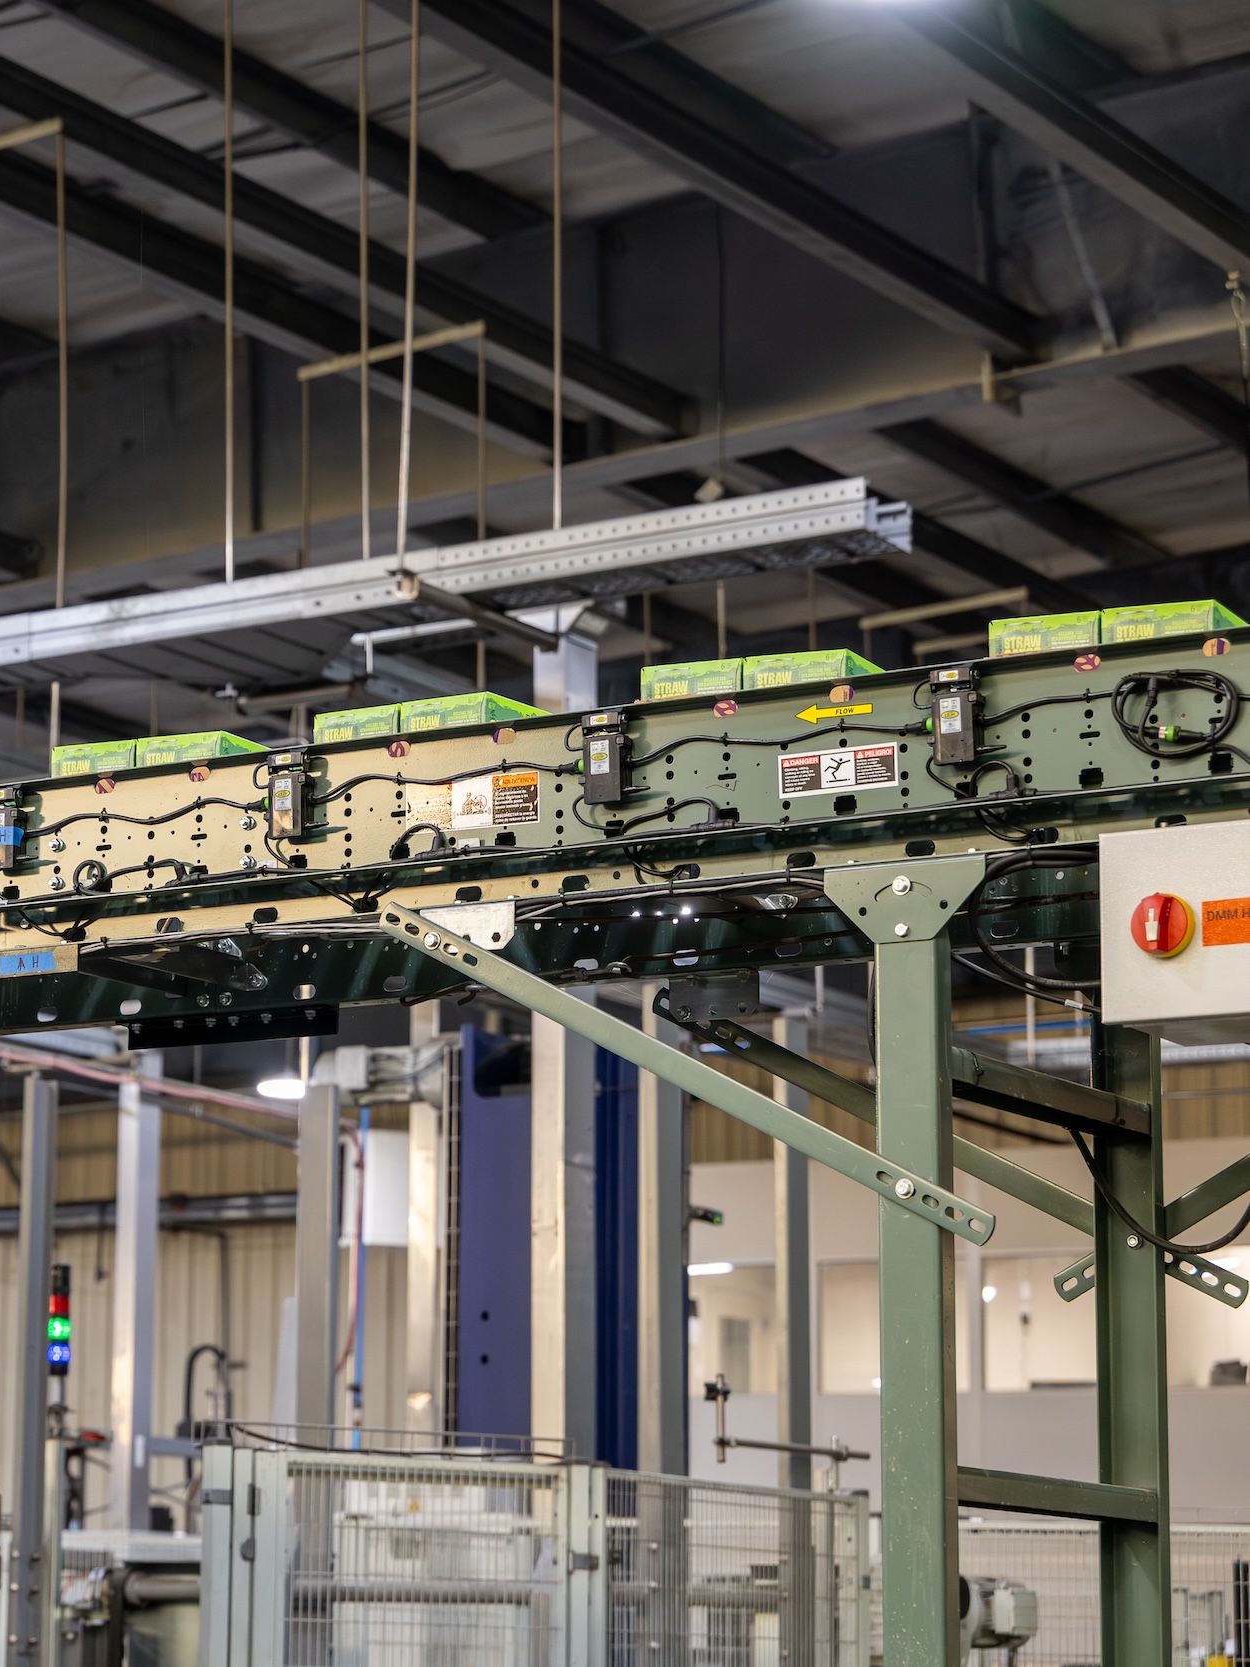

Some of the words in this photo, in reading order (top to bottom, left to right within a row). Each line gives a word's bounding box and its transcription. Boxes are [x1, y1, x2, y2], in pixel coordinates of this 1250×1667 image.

[1116, 623, 1155, 638] STRAW
[1004, 634, 1041, 649] STRAW
[757, 671, 793, 685] STRAW
[654, 680, 689, 694] STRAW
[410, 714, 441, 728] STRAW
[324, 726, 353, 740] STRAW
[146, 751, 176, 763] STRAW
[790, 757, 819, 766] DANGER
[62, 759, 90, 772] STRAW
[0, 829, 7, 842] H
[1207, 908, 1238, 921] DMM
[32, 956, 39, 968] H
